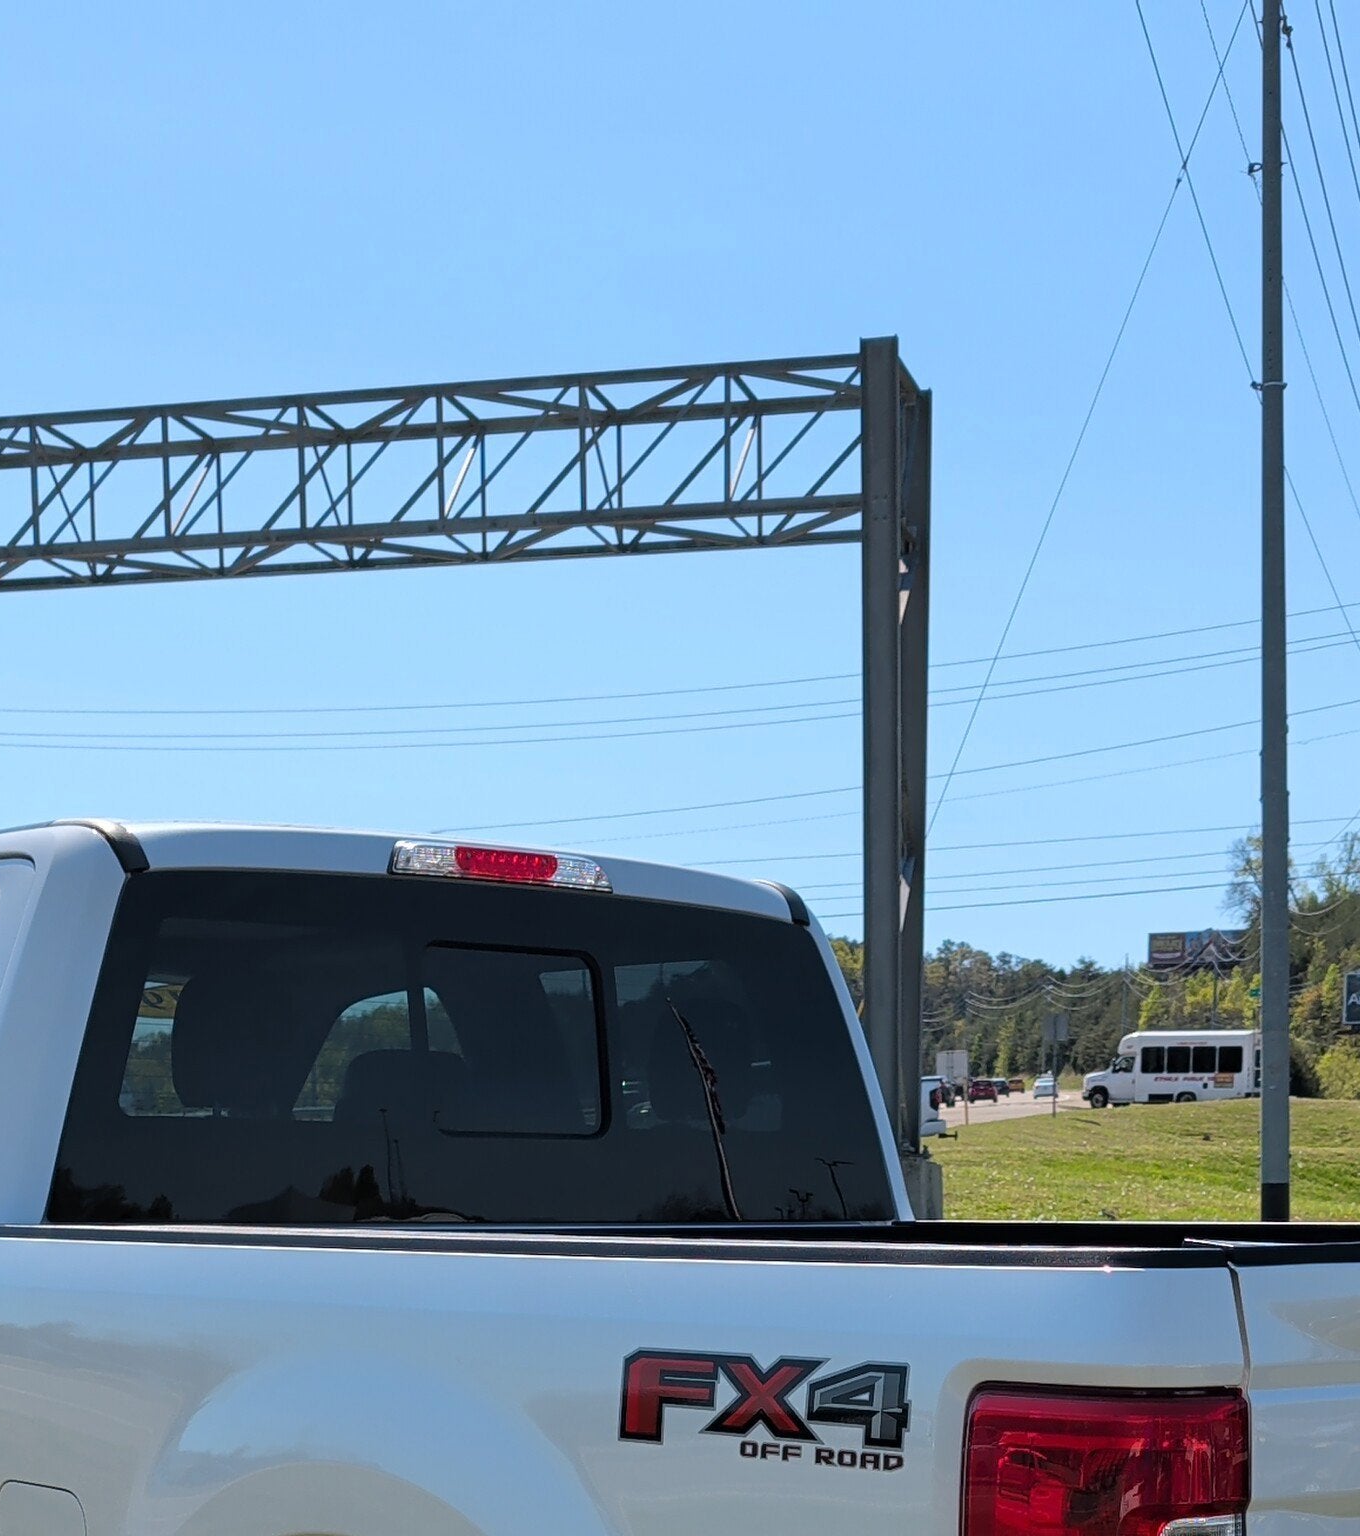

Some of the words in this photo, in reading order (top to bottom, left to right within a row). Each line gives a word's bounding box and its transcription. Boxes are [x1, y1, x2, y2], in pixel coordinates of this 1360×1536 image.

[618, 1346, 912, 1451] FX4
[740, 1440, 802, 1462] OFF
[814, 1446, 904, 1471] ROAD
